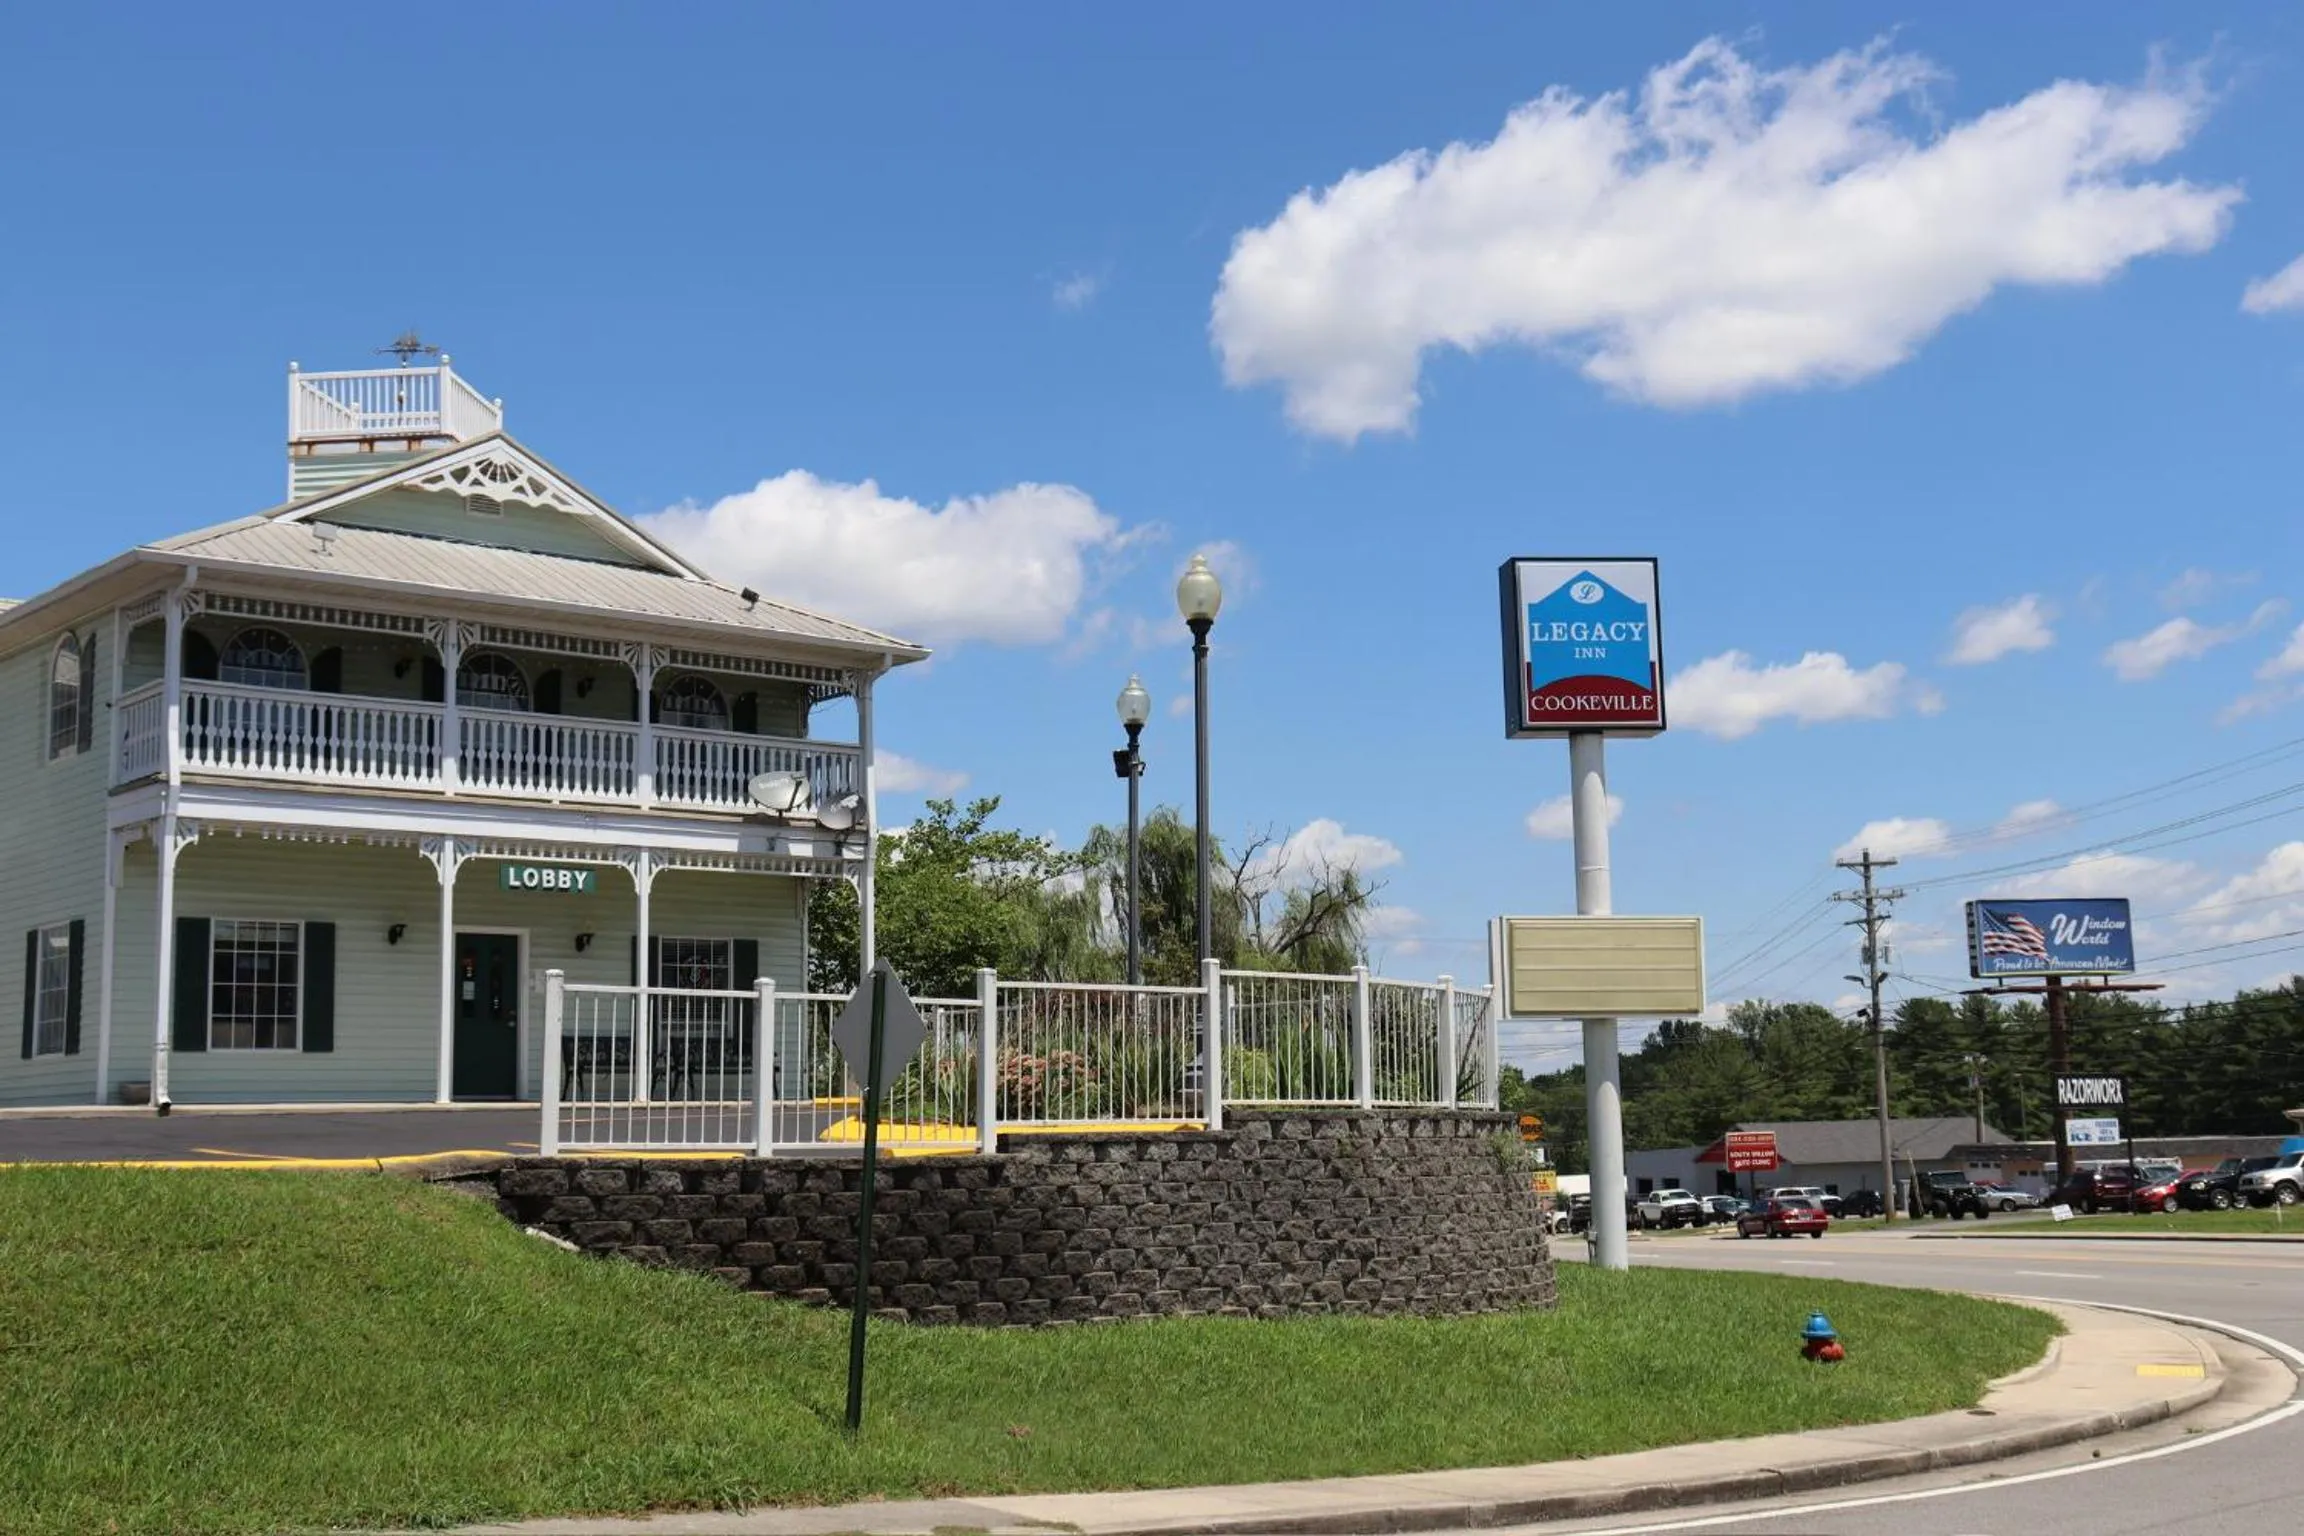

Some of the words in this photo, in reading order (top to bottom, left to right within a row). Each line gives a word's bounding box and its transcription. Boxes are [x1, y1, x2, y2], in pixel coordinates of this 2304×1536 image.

[1531, 621, 1647, 642] LEGACY
[1574, 647, 1607, 659] INN
[1531, 695, 1654, 711] COOKEVILLE
[507, 867, 588, 890] LOBBY
[2051, 913, 2126, 946] Window
[2058, 1078, 2123, 1104] RAZORWORX
